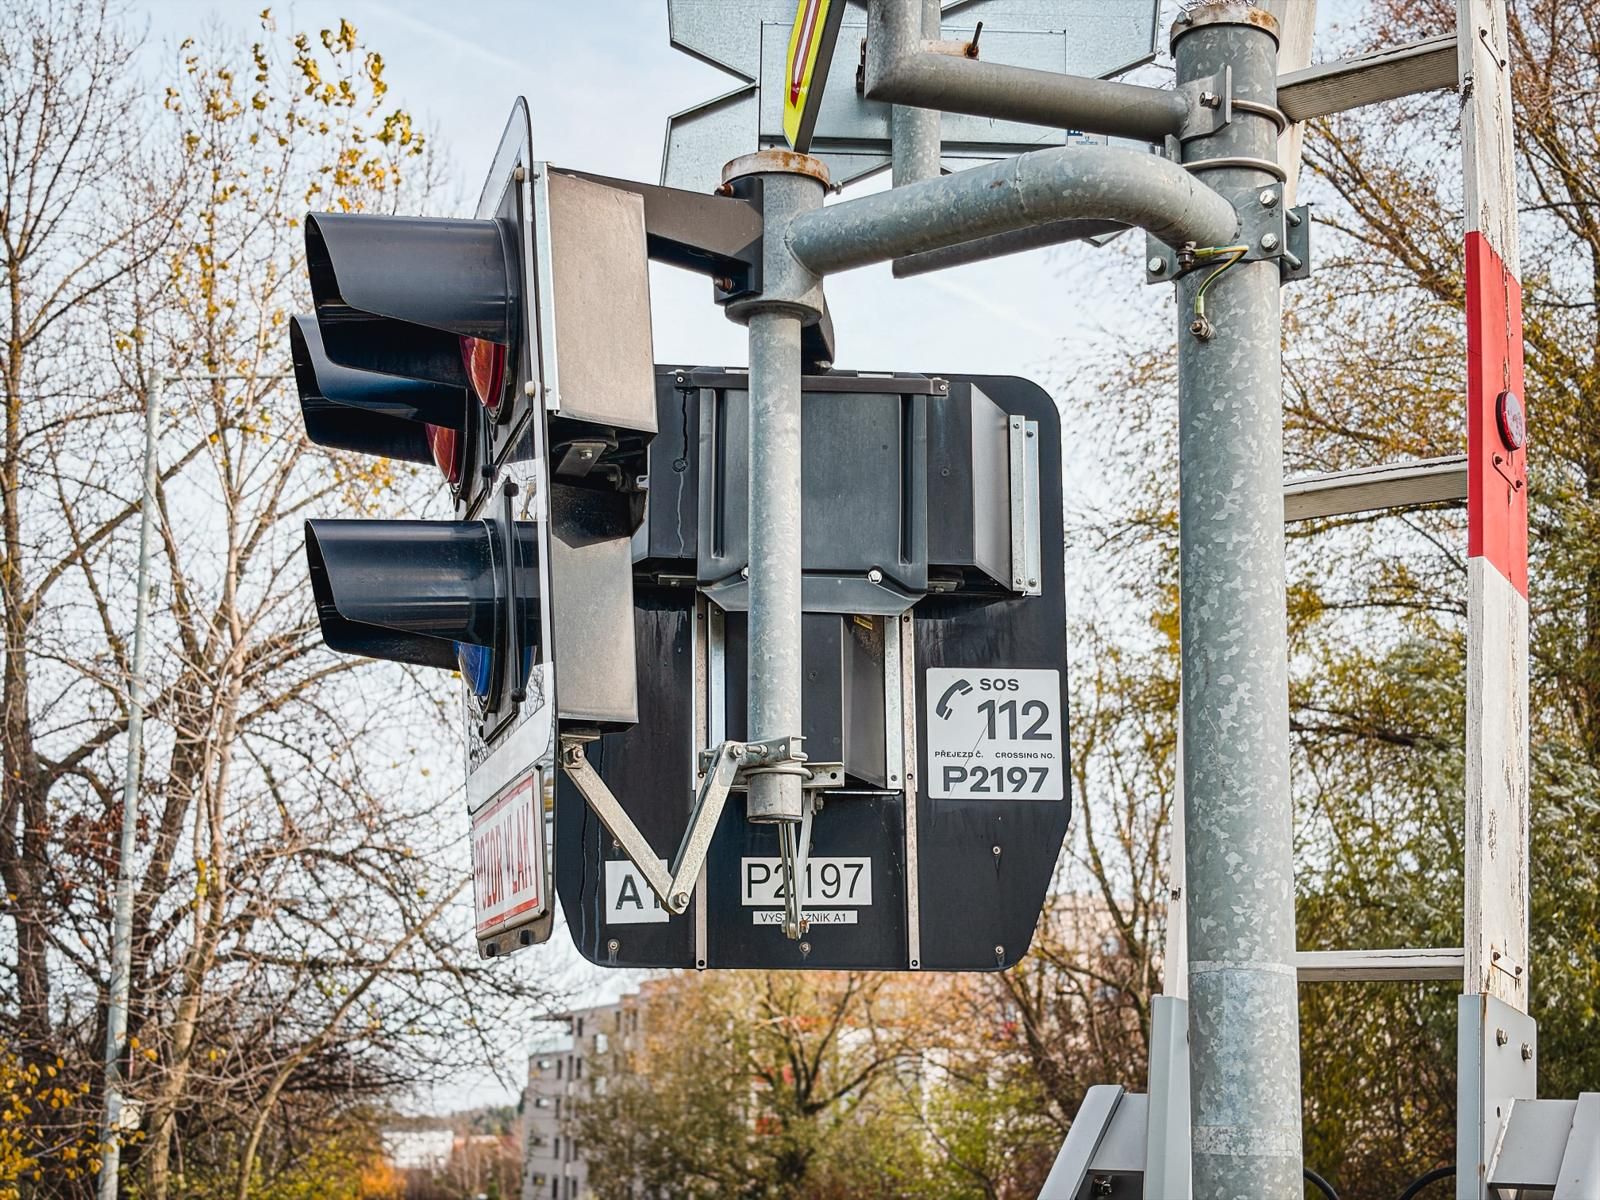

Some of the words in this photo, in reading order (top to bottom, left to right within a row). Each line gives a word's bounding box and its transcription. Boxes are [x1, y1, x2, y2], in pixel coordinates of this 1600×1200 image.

[979, 678, 1020, 692] SOS
[977, 699, 1053, 741] 112
[934, 750, 974, 758] PŘEJEZD
[942, 765, 1050, 794] P2197
[504, 802, 533, 897] VLAK
[747, 863, 864, 899] P2197
[760, 912, 830, 922] VÝSŽNÍK
[833, 913, 846, 922] A1
